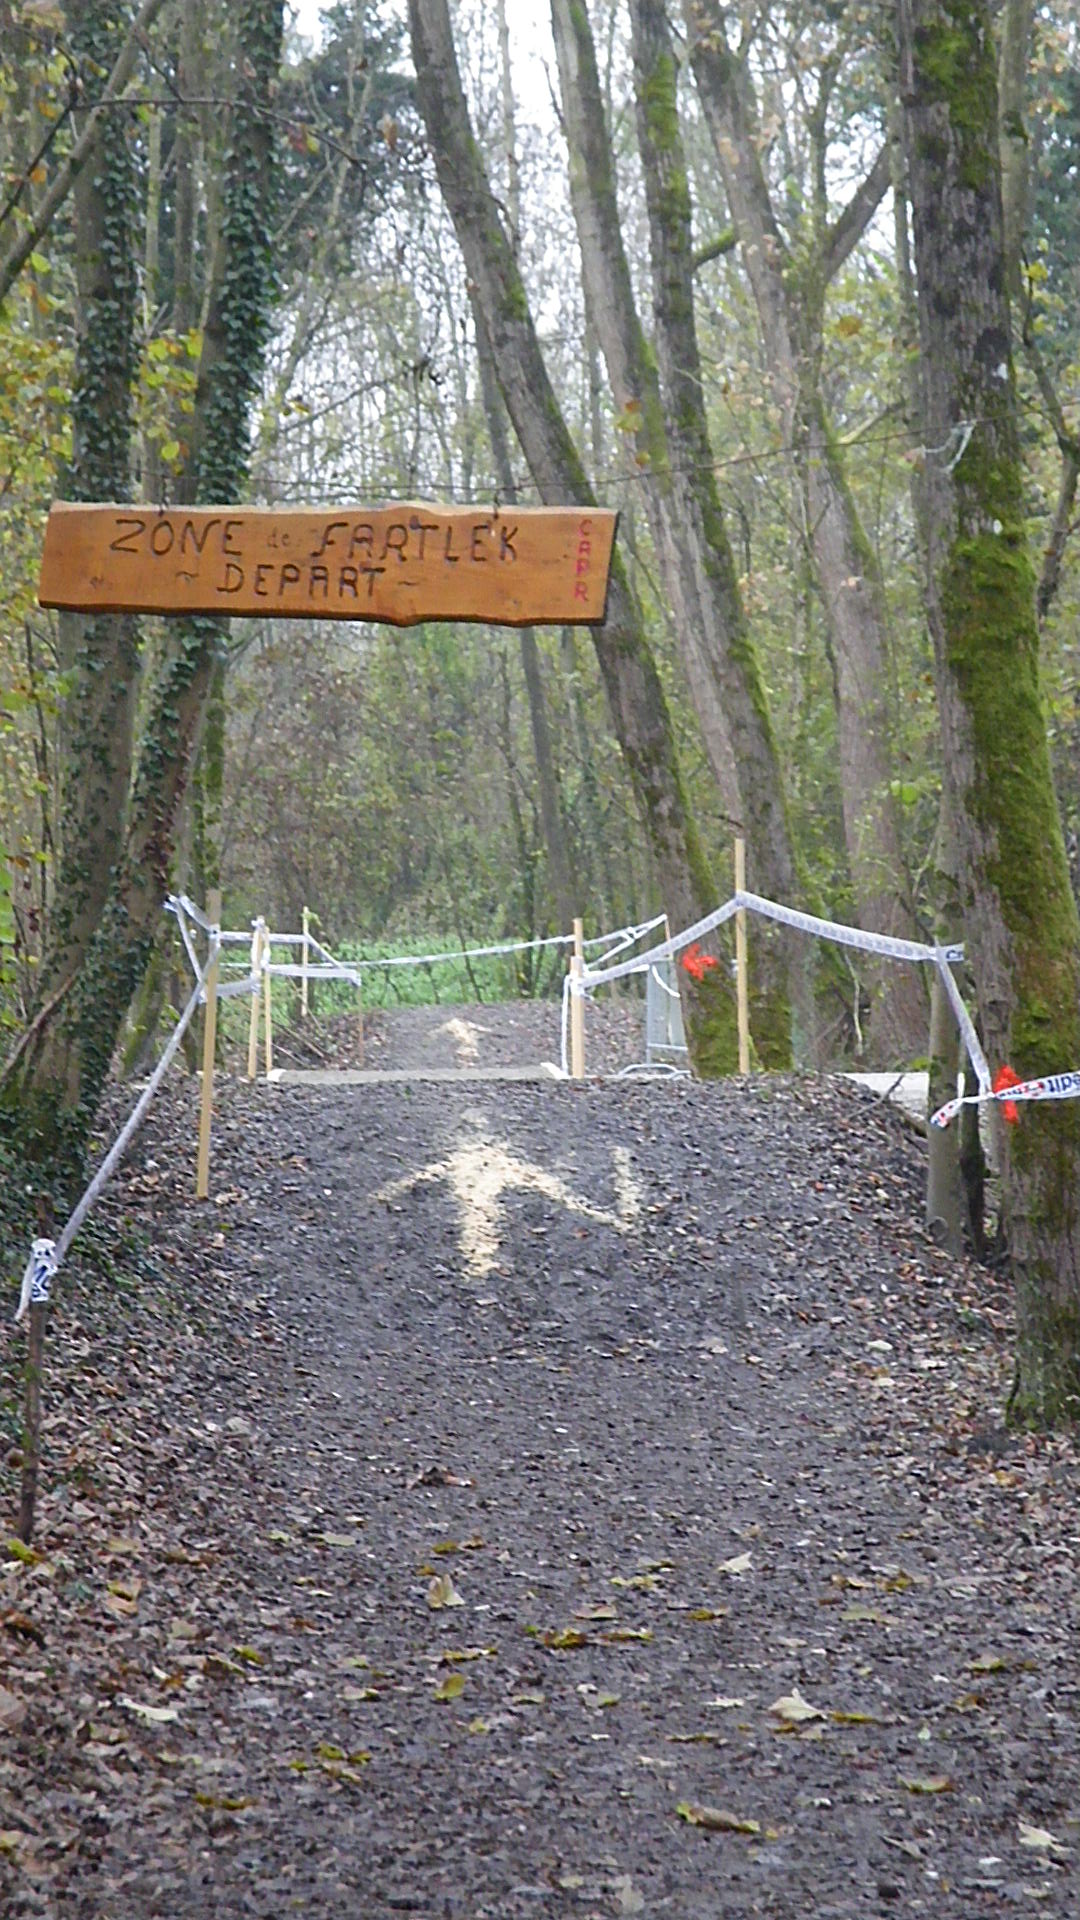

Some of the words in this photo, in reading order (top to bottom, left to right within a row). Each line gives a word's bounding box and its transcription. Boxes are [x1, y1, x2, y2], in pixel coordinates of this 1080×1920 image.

[109, 519, 244, 556] ZONE
[310, 521, 518, 562] FARTLEK
[216, 563, 386, 598] DEPART
